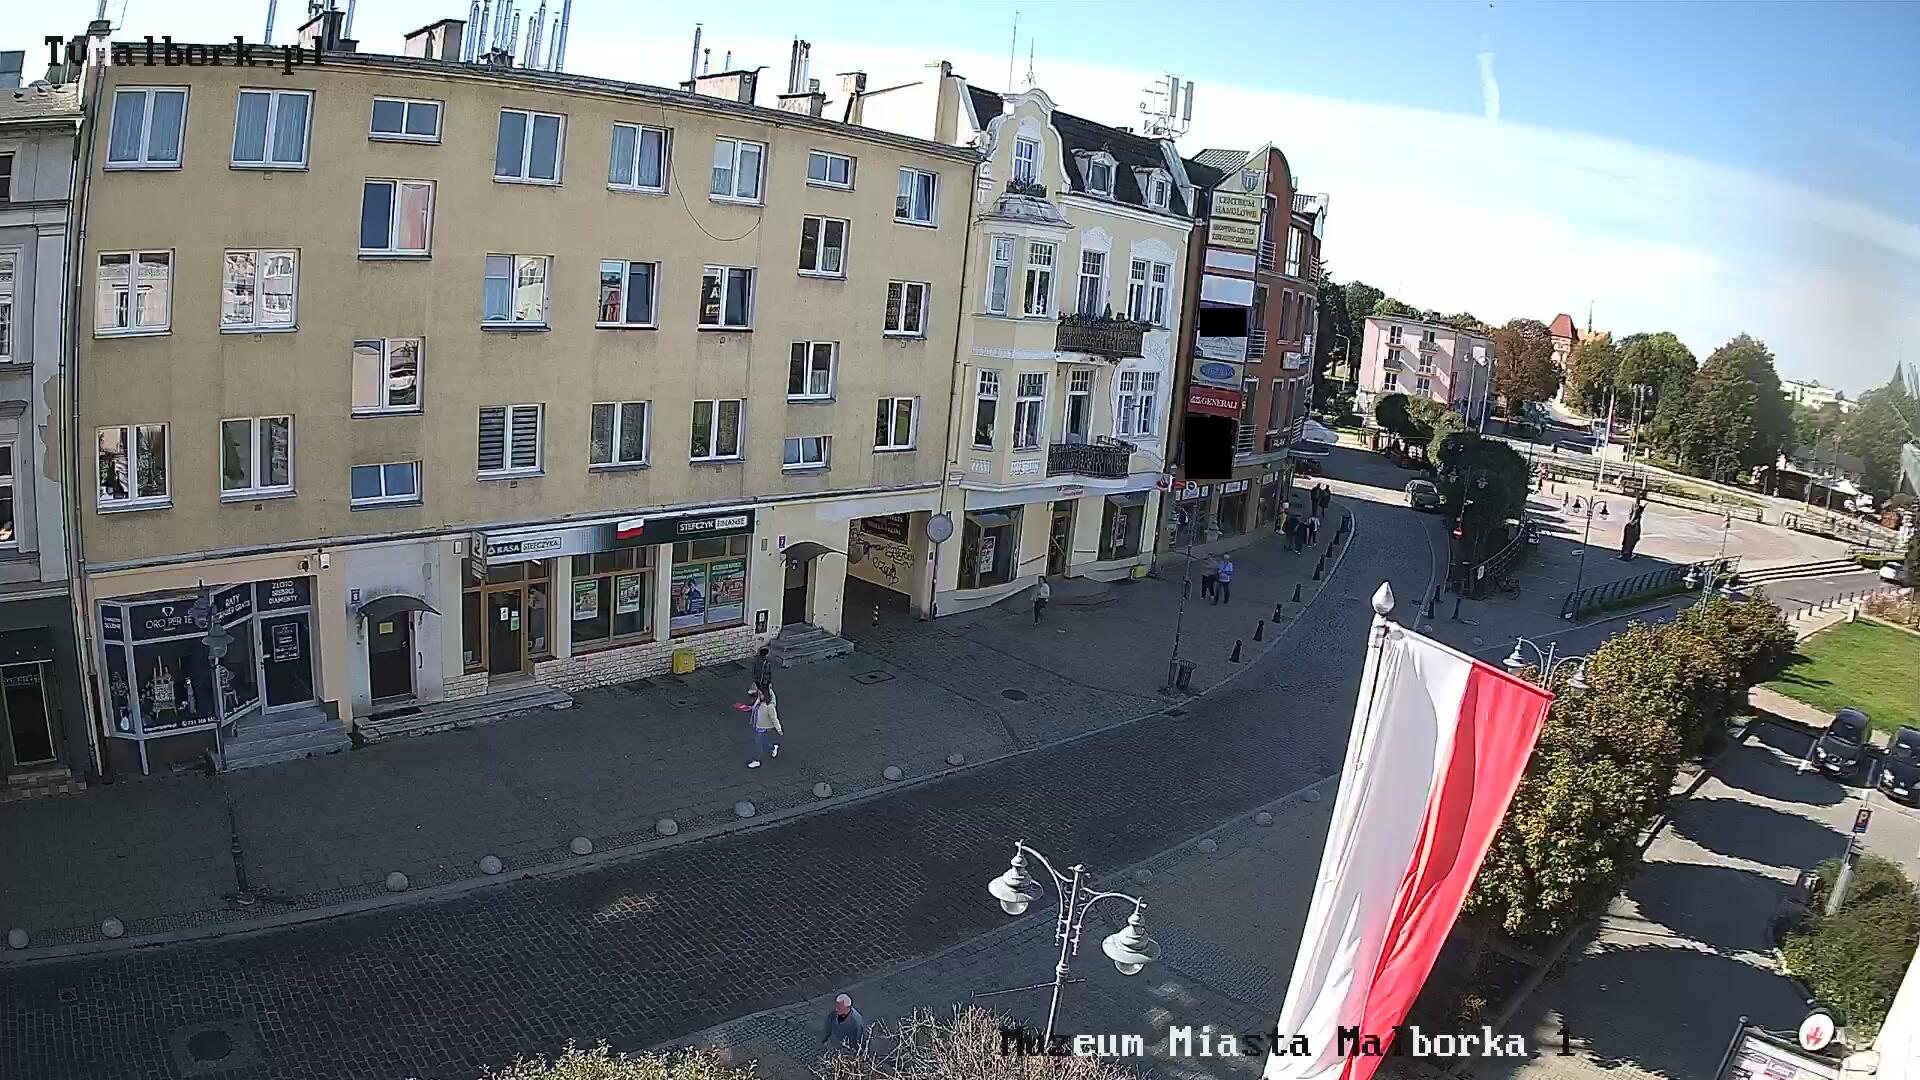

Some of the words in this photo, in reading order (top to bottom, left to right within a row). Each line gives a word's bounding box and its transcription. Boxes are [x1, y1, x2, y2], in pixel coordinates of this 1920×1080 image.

[1201, 397, 1238, 409] GENERALI
[679, 520, 714, 531] STEFCZYK
[497, 544, 520, 554] KASA
[145, 618, 166, 629] ORO
